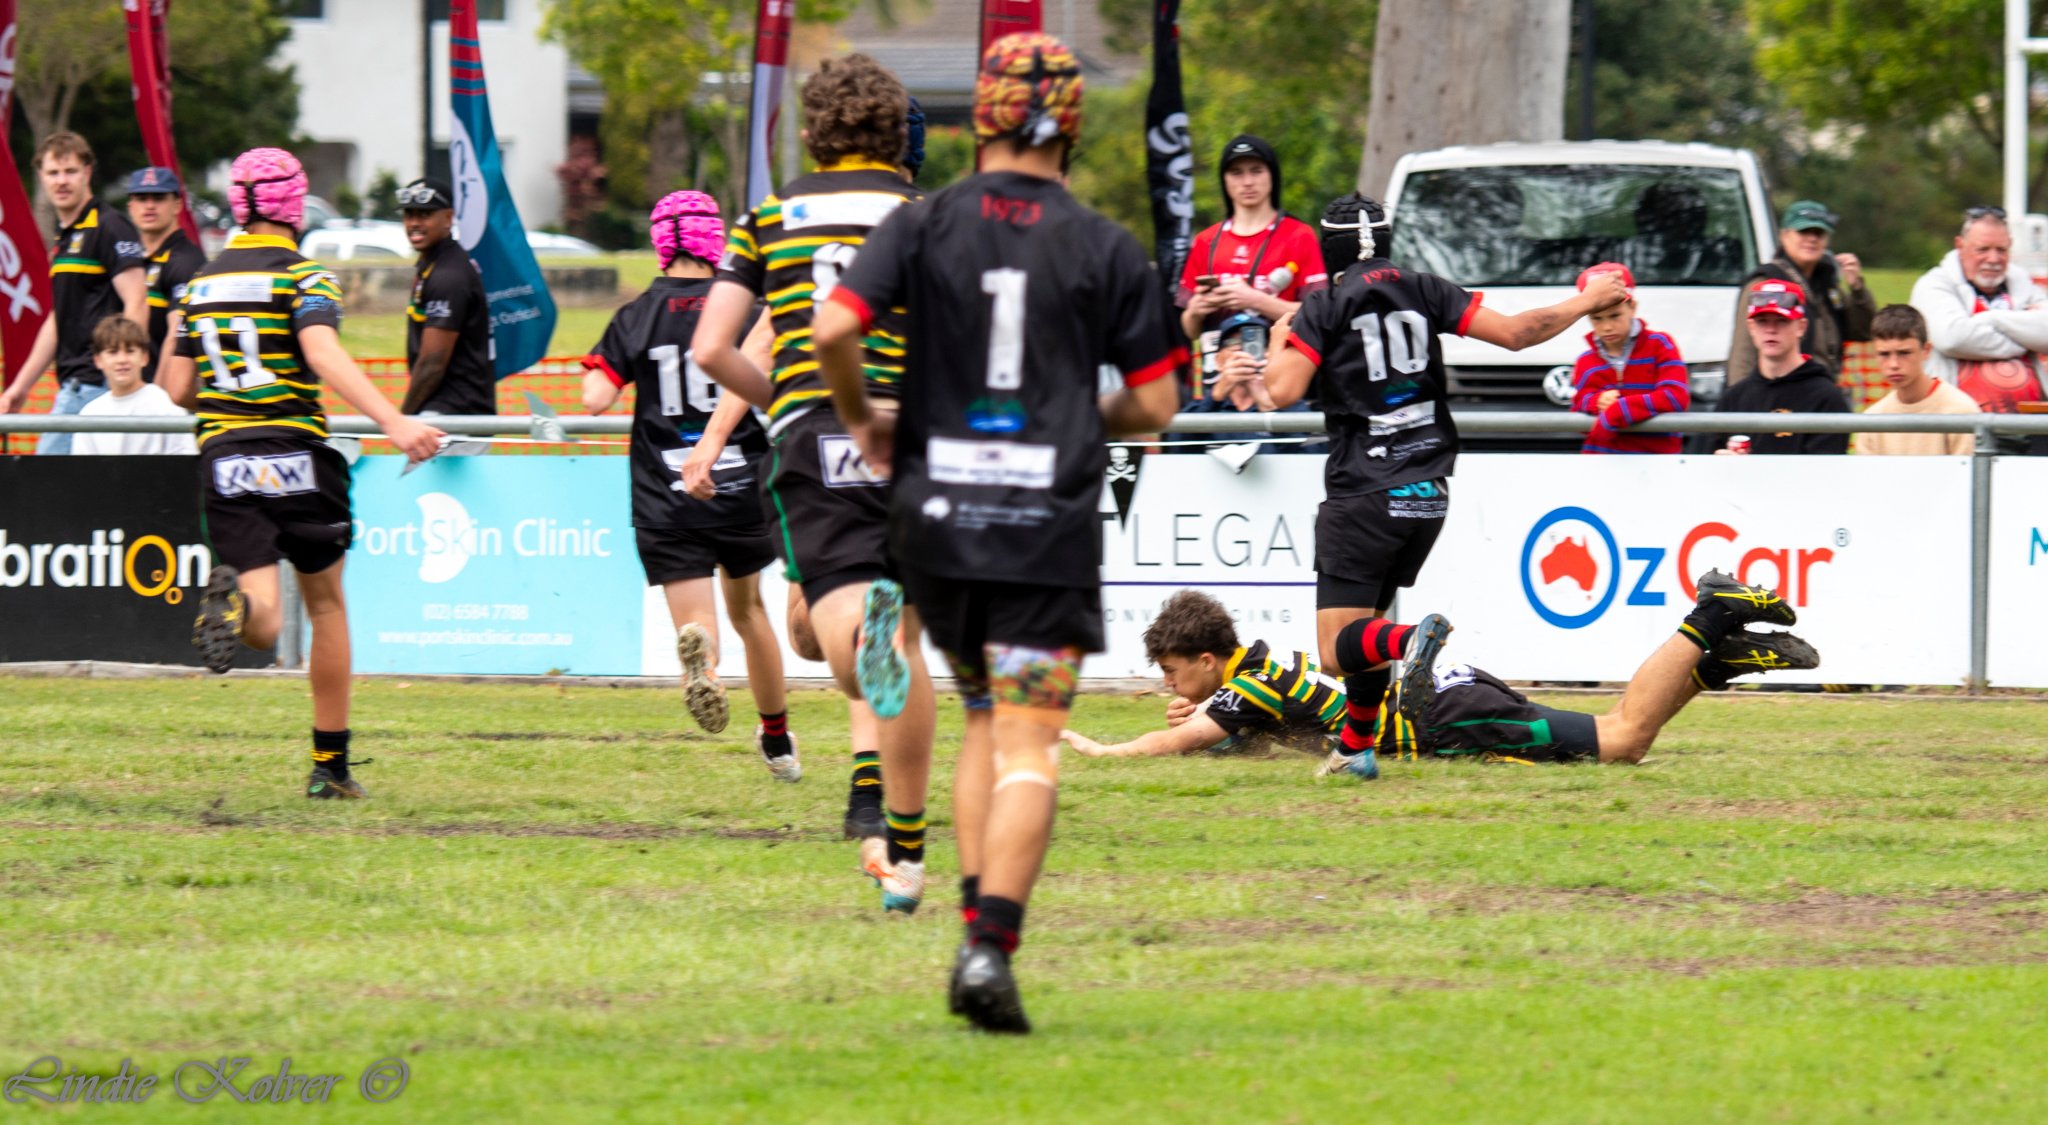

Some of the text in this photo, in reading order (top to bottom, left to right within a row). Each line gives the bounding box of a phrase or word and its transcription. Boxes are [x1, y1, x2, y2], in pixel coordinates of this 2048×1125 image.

[194, 316, 278, 393] 11
[981, 267, 1027, 391] 1
[1351, 310, 1430, 382] 10
[430, 518, 500, 556] Skin
[513, 518, 612, 556] Clinic
[1134, 512, 1316, 567] LEGA
